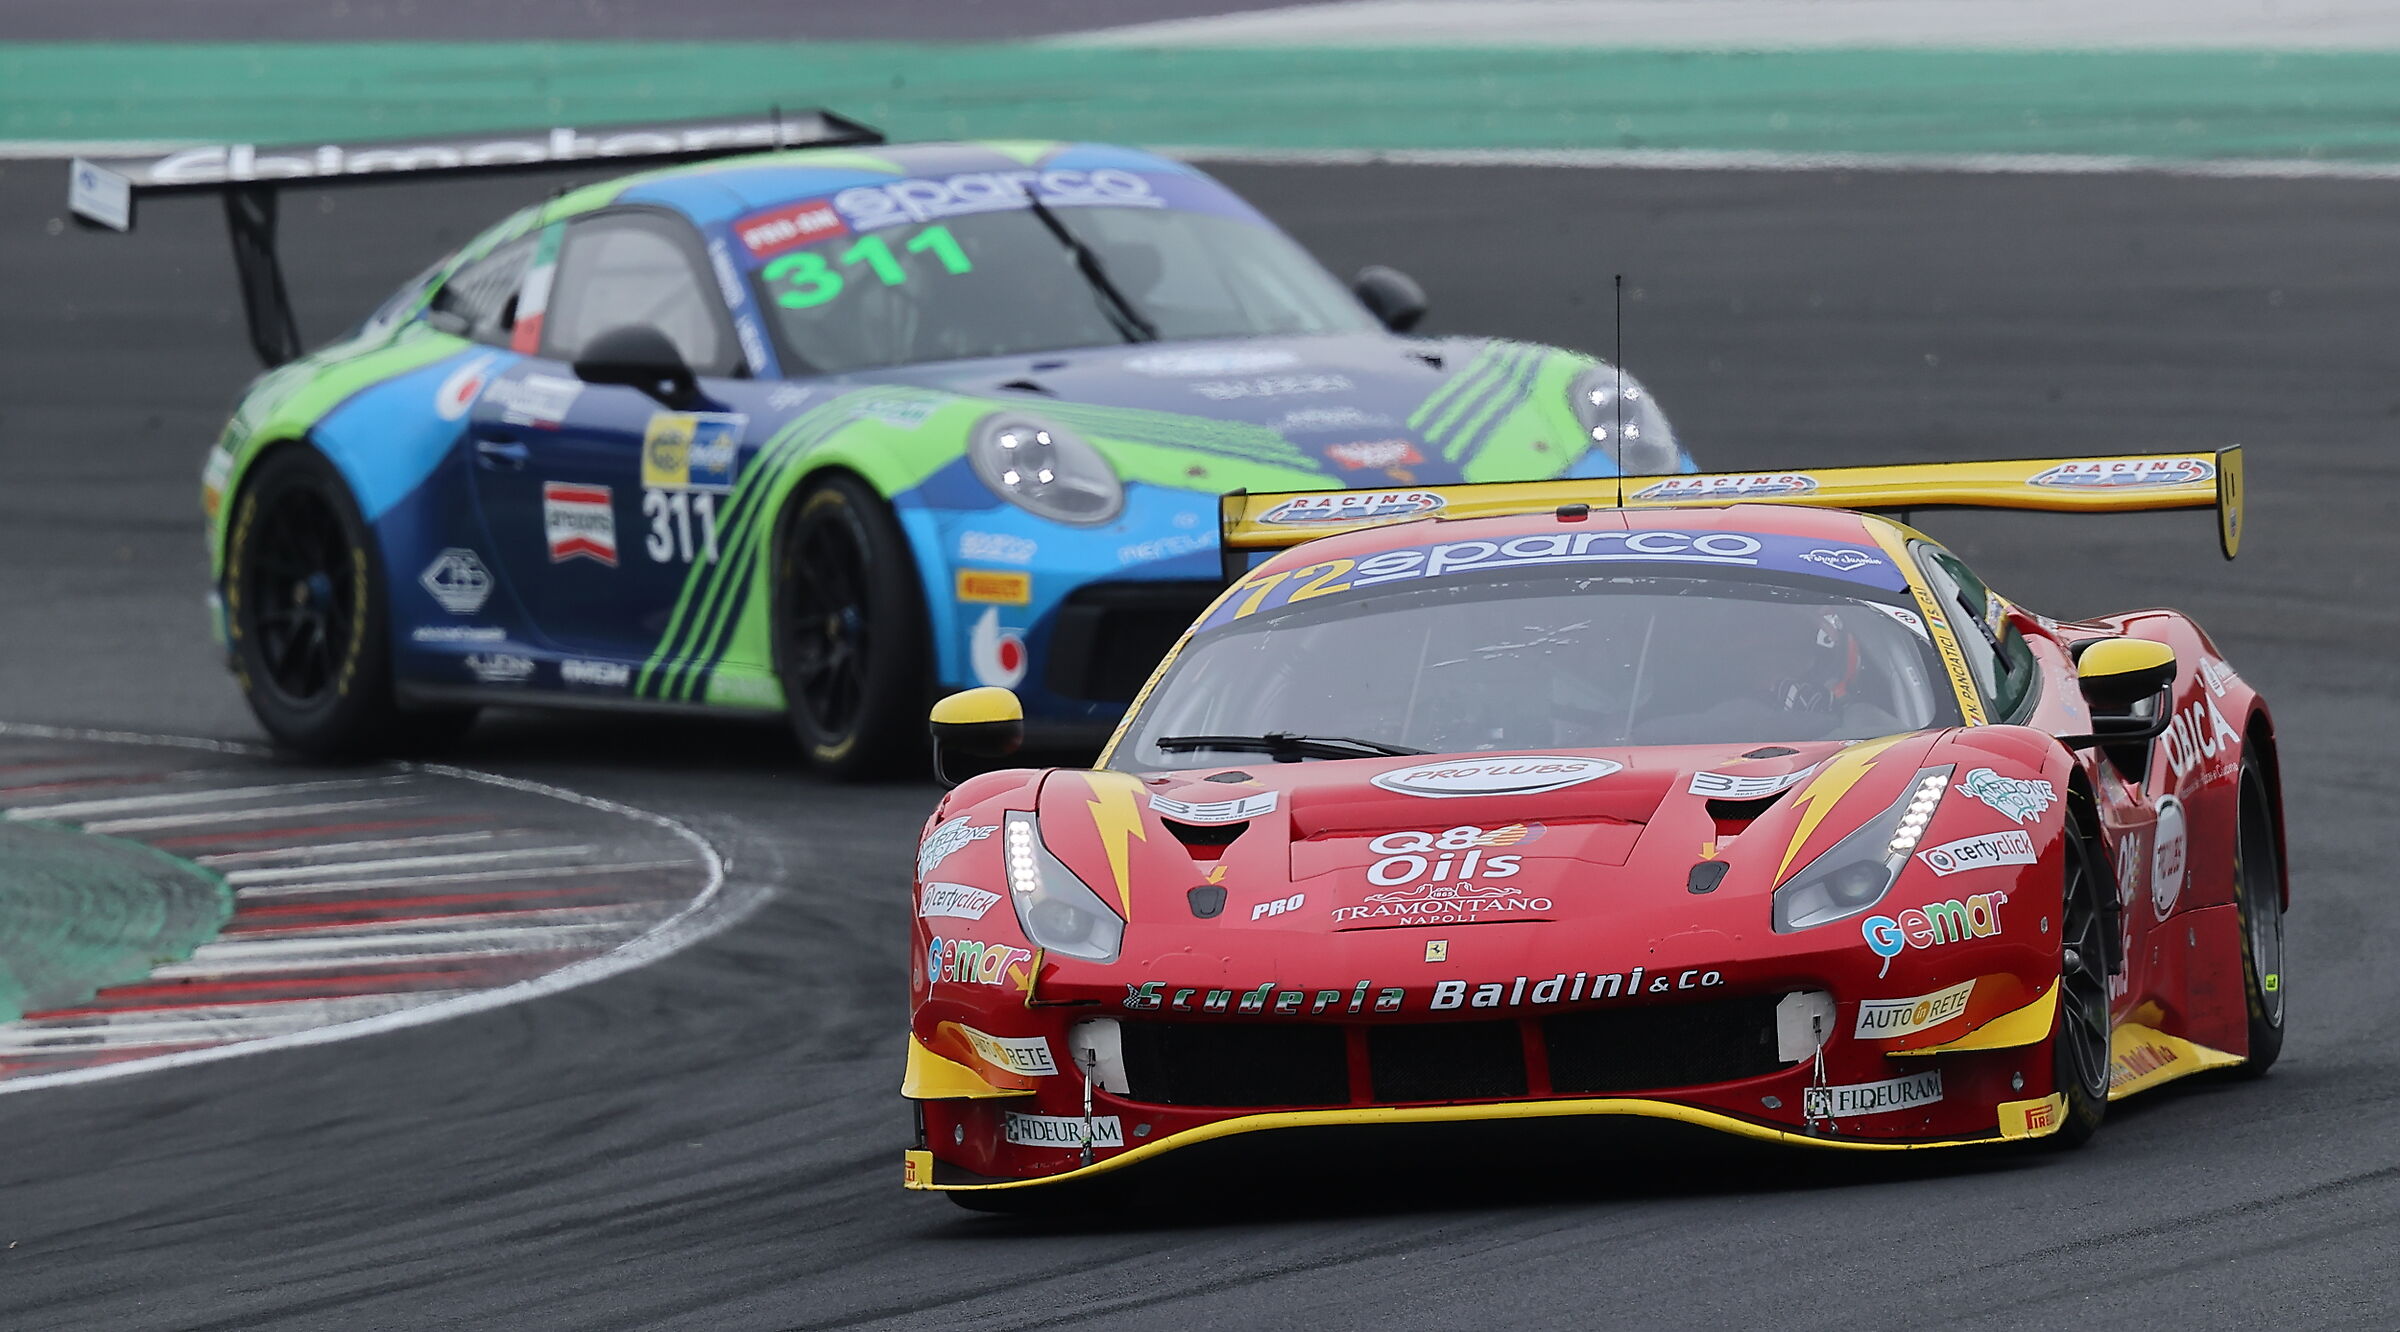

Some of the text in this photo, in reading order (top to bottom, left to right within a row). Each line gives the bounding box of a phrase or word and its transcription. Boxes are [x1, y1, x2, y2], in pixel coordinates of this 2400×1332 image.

[835, 168, 1166, 231] sparco
[762, 225, 973, 309] 311
[1666, 476, 1794, 489] RACING
[2064, 460, 2192, 474] RACING
[1293, 493, 1422, 508] RACING
[642, 487, 719, 564] 311
[1233, 531, 1762, 620] 72 sparco
[1369, 826, 1483, 854] Q8
[1953, 833, 2034, 862] certyclick
[1366, 850, 1523, 887] Oils
[932, 888, 995, 913] certyclick
[1251, 893, 1305, 921] PRO
[1331, 897, 1553, 923] TRAMONTANO
[1400, 914, 1477, 925] NAPOLI
[1861, 889, 2009, 958] Gemar
[928, 936, 1032, 985] Gemar
[1137, 980, 1405, 1015] Scuderia
[1429, 966, 1645, 1011] Baldini
[1861, 1008, 1913, 1029] AUTO
[1929, 988, 1970, 1018] RETE
[1005, 1047, 1051, 1066] RETE
[1838, 1076, 1943, 1112] FIDEURAM
